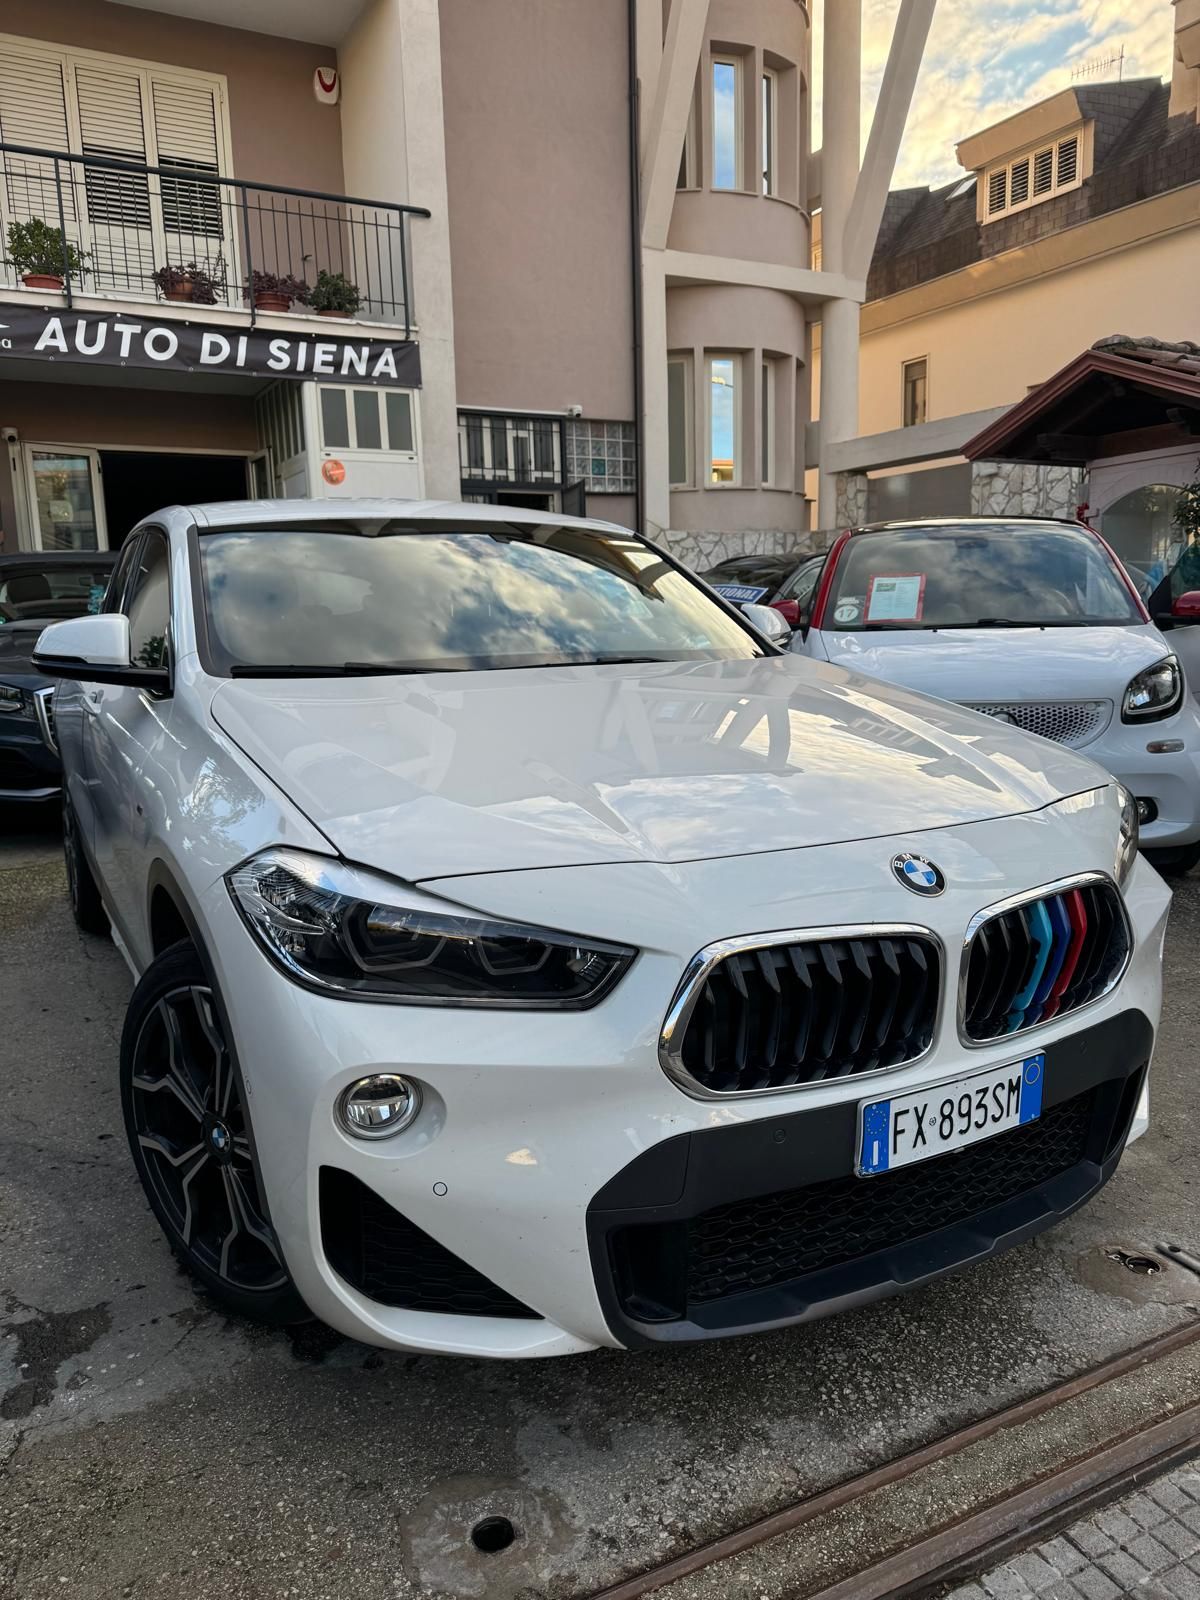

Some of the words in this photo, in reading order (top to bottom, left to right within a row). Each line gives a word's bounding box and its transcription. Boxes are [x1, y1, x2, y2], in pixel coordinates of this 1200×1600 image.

[0, 338, 12, 349] a
[34, 317, 179, 362] AUTO
[200, 332, 248, 367] DI
[266, 338, 399, 379] SIENA
[894, 853, 929, 868] BMW
[893, 1103, 928, 1154] FX
[939, 1075, 1022, 1141] 893SM
